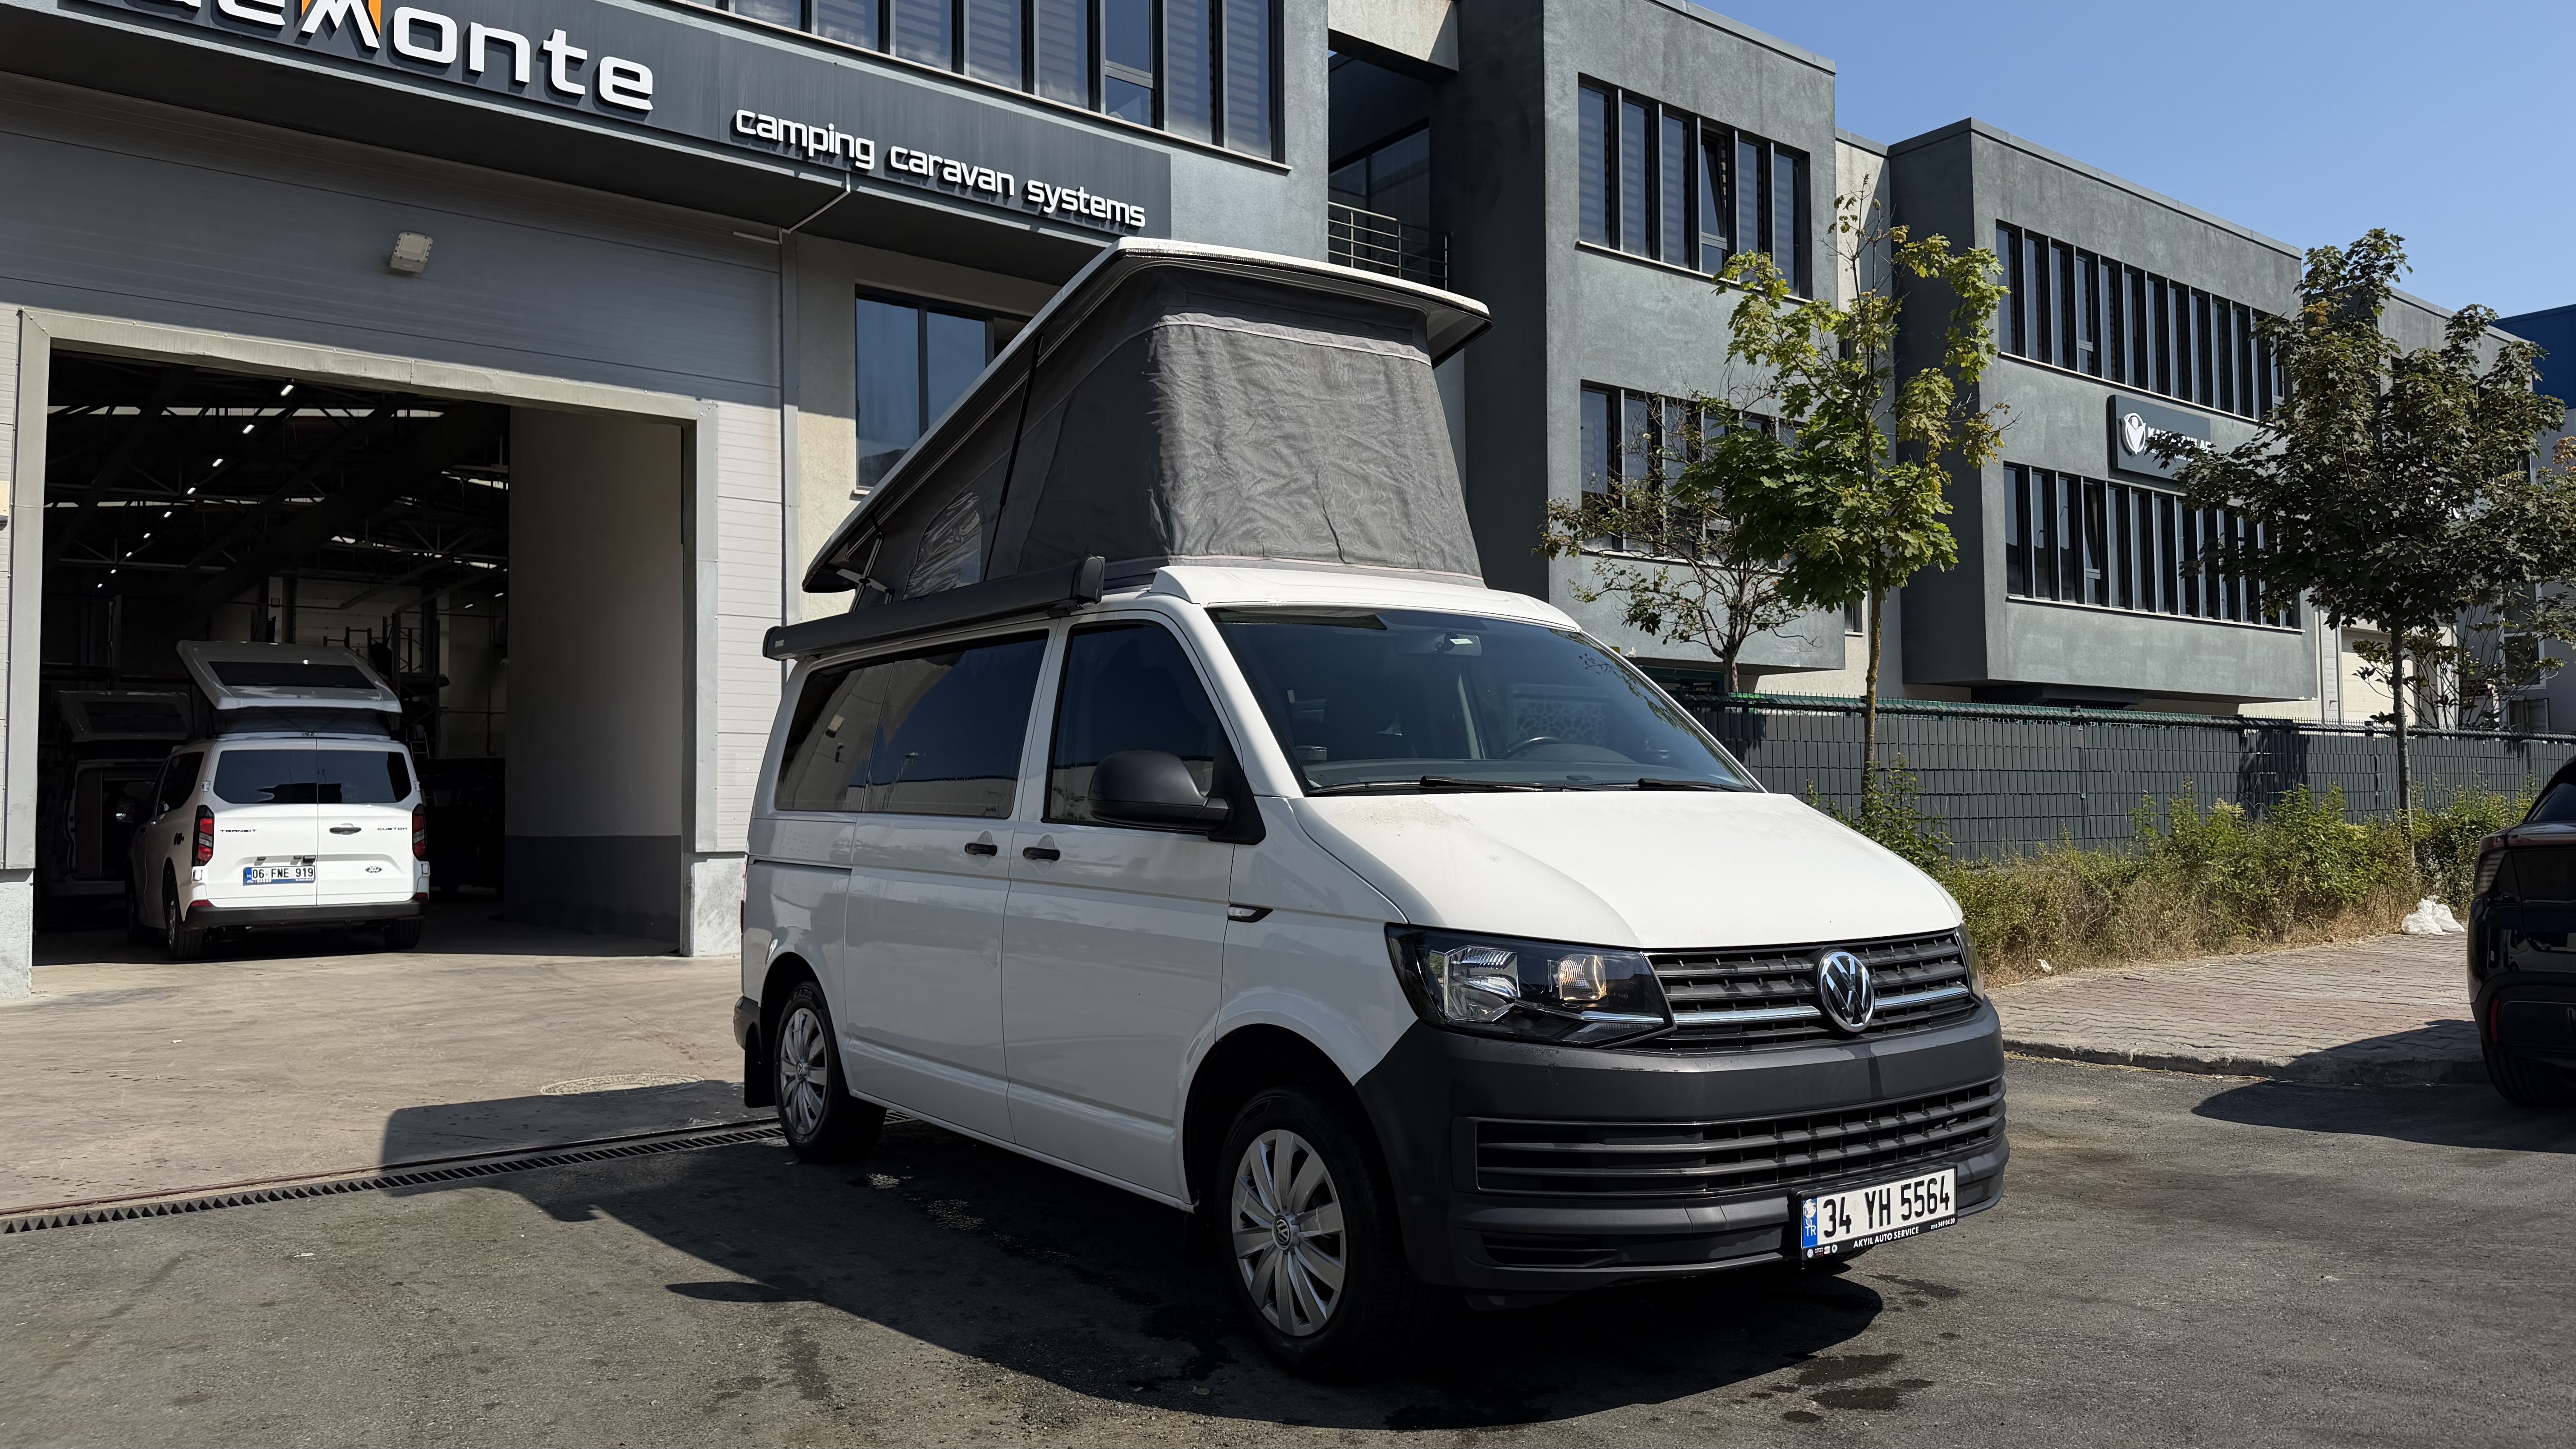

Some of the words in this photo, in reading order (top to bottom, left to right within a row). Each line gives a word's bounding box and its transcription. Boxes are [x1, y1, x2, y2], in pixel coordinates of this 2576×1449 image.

[736, 109, 875, 170] camping
[890, 145, 1014, 196] caravan
[1027, 179, 1146, 228] systems
[253, 869, 264, 879] 06
[271, 868, 289, 878] FNE
[295, 868, 313, 877] 919
[1823, 1196, 1852, 1238] 34
[1864, 1187, 1891, 1229] YH
[1900, 1175, 1950, 1221] 5564
[1805, 1225, 1817, 1237] TR
[1853, 1237, 1874, 1248] AKYIL
[1874, 1232, 1893, 1244] AUTO
[1894, 1226, 1919, 1239] SERVICE
